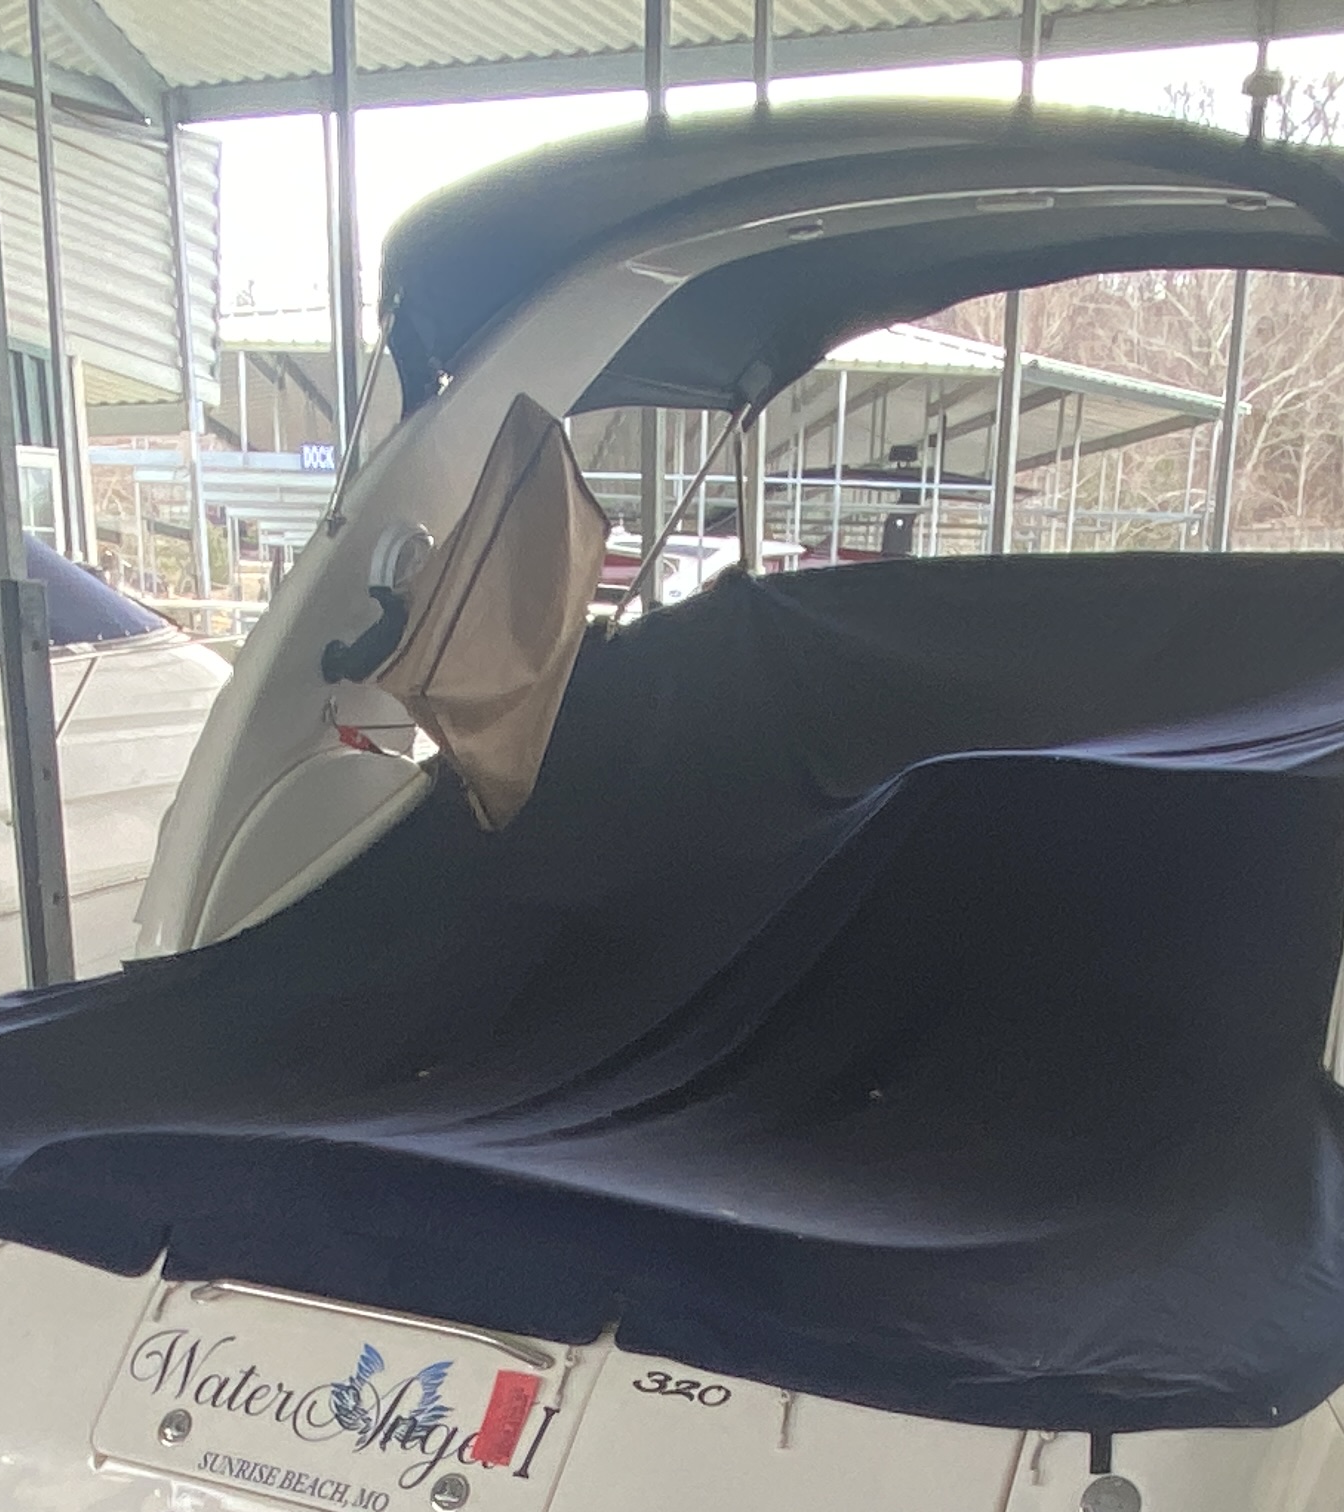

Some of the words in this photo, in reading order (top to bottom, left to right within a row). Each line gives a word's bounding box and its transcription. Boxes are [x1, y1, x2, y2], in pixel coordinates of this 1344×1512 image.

[130, 1329, 298, 1423] Water
[293, 1375, 514, 1489] Ange
[632, 1370, 732, 1407] 320
[197, 1451, 282, 1486] SUNRISE
[278, 1469, 351, 1507] BEACH,
